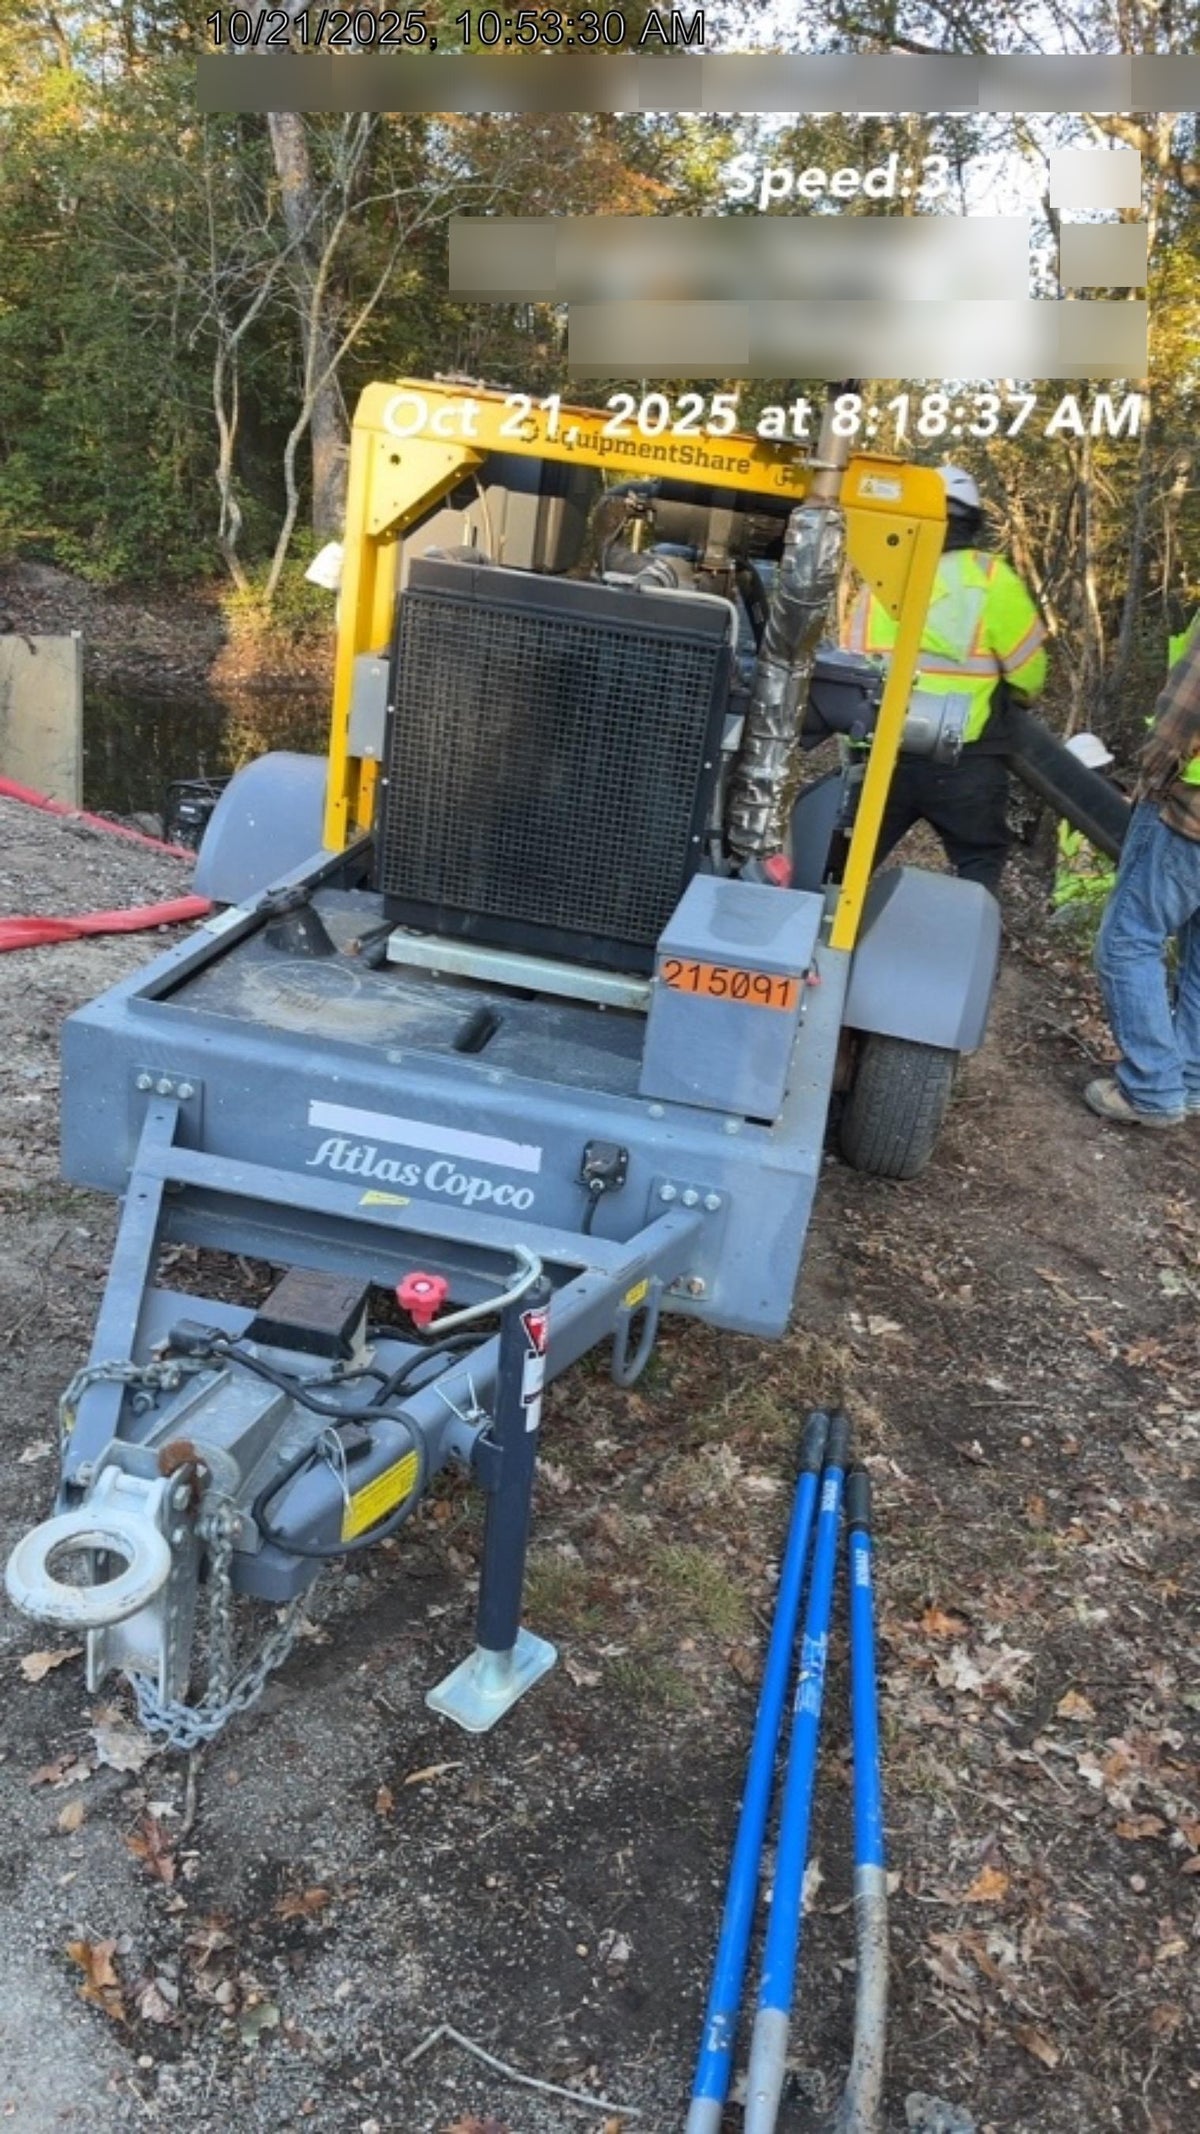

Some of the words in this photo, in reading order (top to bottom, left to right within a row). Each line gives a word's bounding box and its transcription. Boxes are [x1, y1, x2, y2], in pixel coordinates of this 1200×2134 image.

[664, 959, 791, 1007] 215091
[306, 1136, 422, 1187] Atlas
[423, 1160, 536, 1211] Copco
